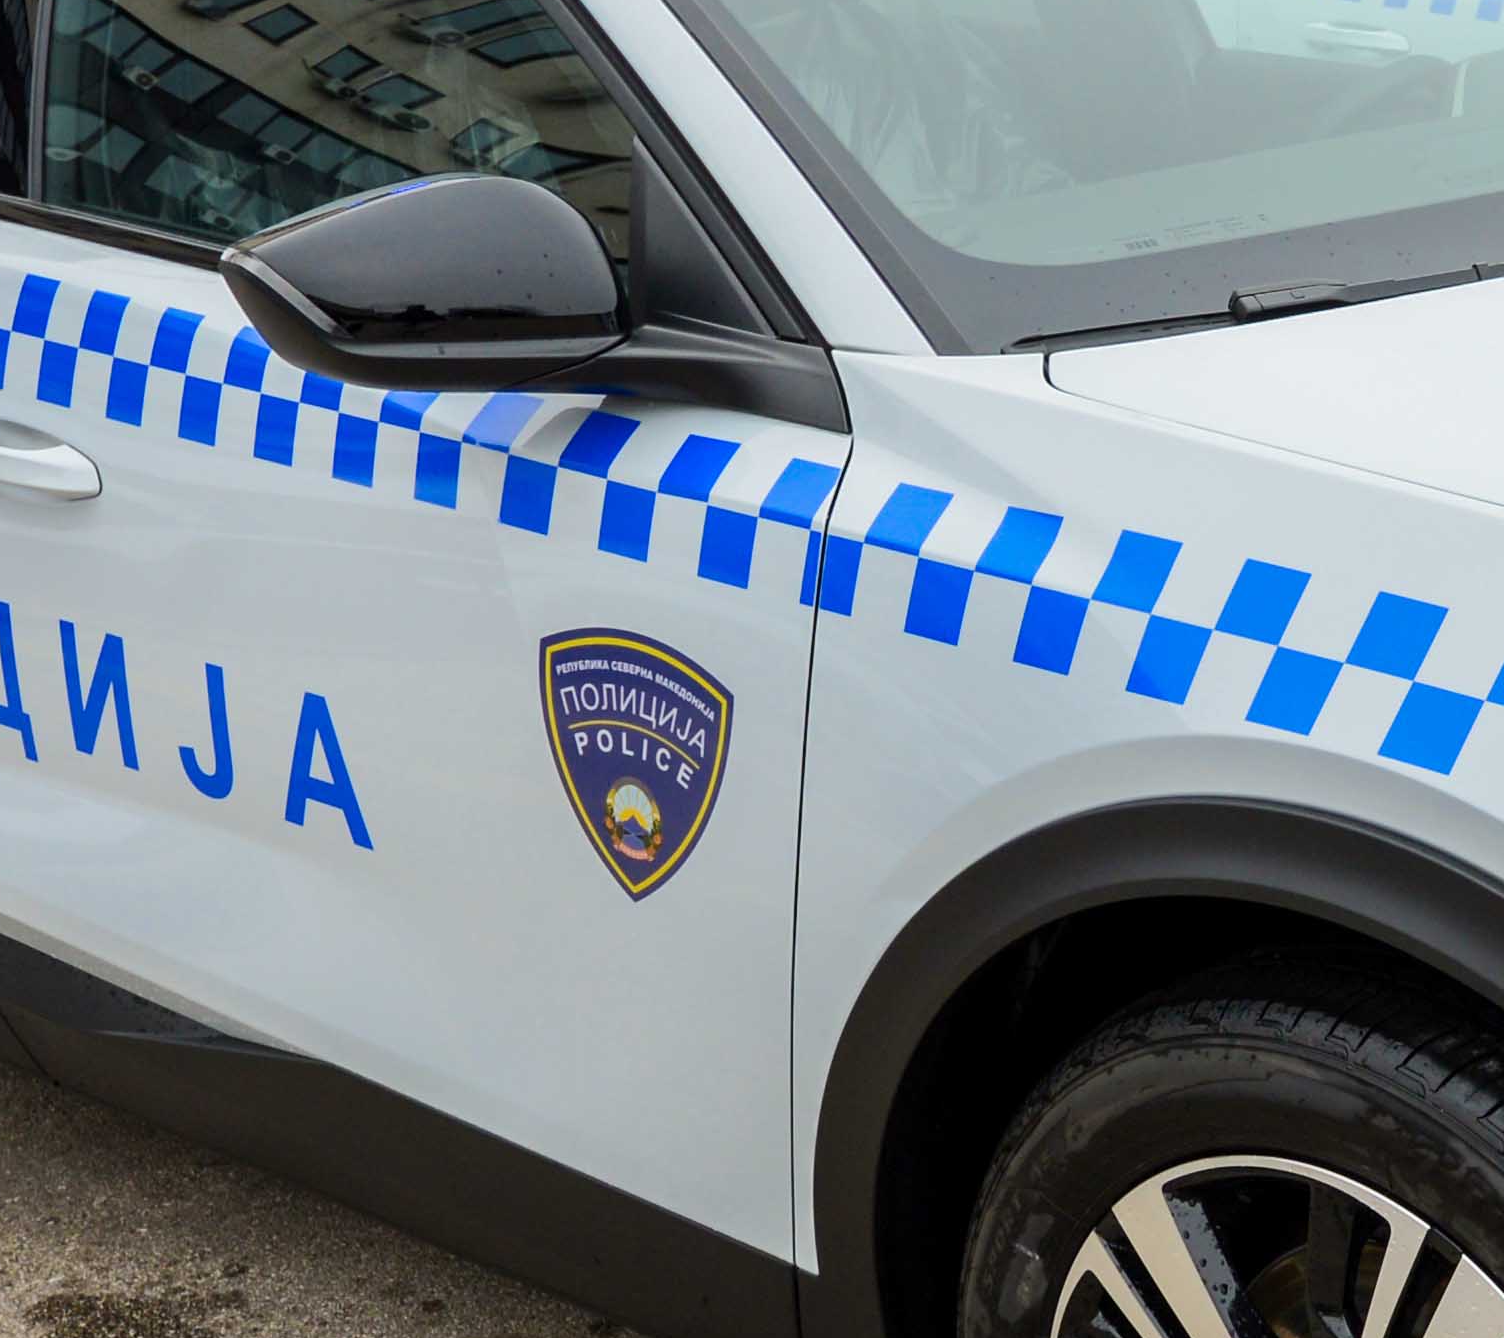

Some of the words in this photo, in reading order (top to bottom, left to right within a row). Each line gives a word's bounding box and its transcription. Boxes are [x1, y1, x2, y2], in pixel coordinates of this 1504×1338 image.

[555, 659, 610, 676] РЕПУБЛИКА
[611, 661, 654, 681] СЕВЕРНА
[655, 673, 715, 722] МАКЕДОНИЈА
[559, 683, 707, 758] ПОЛИЦИЈА
[574, 729, 695, 790] POLICE
